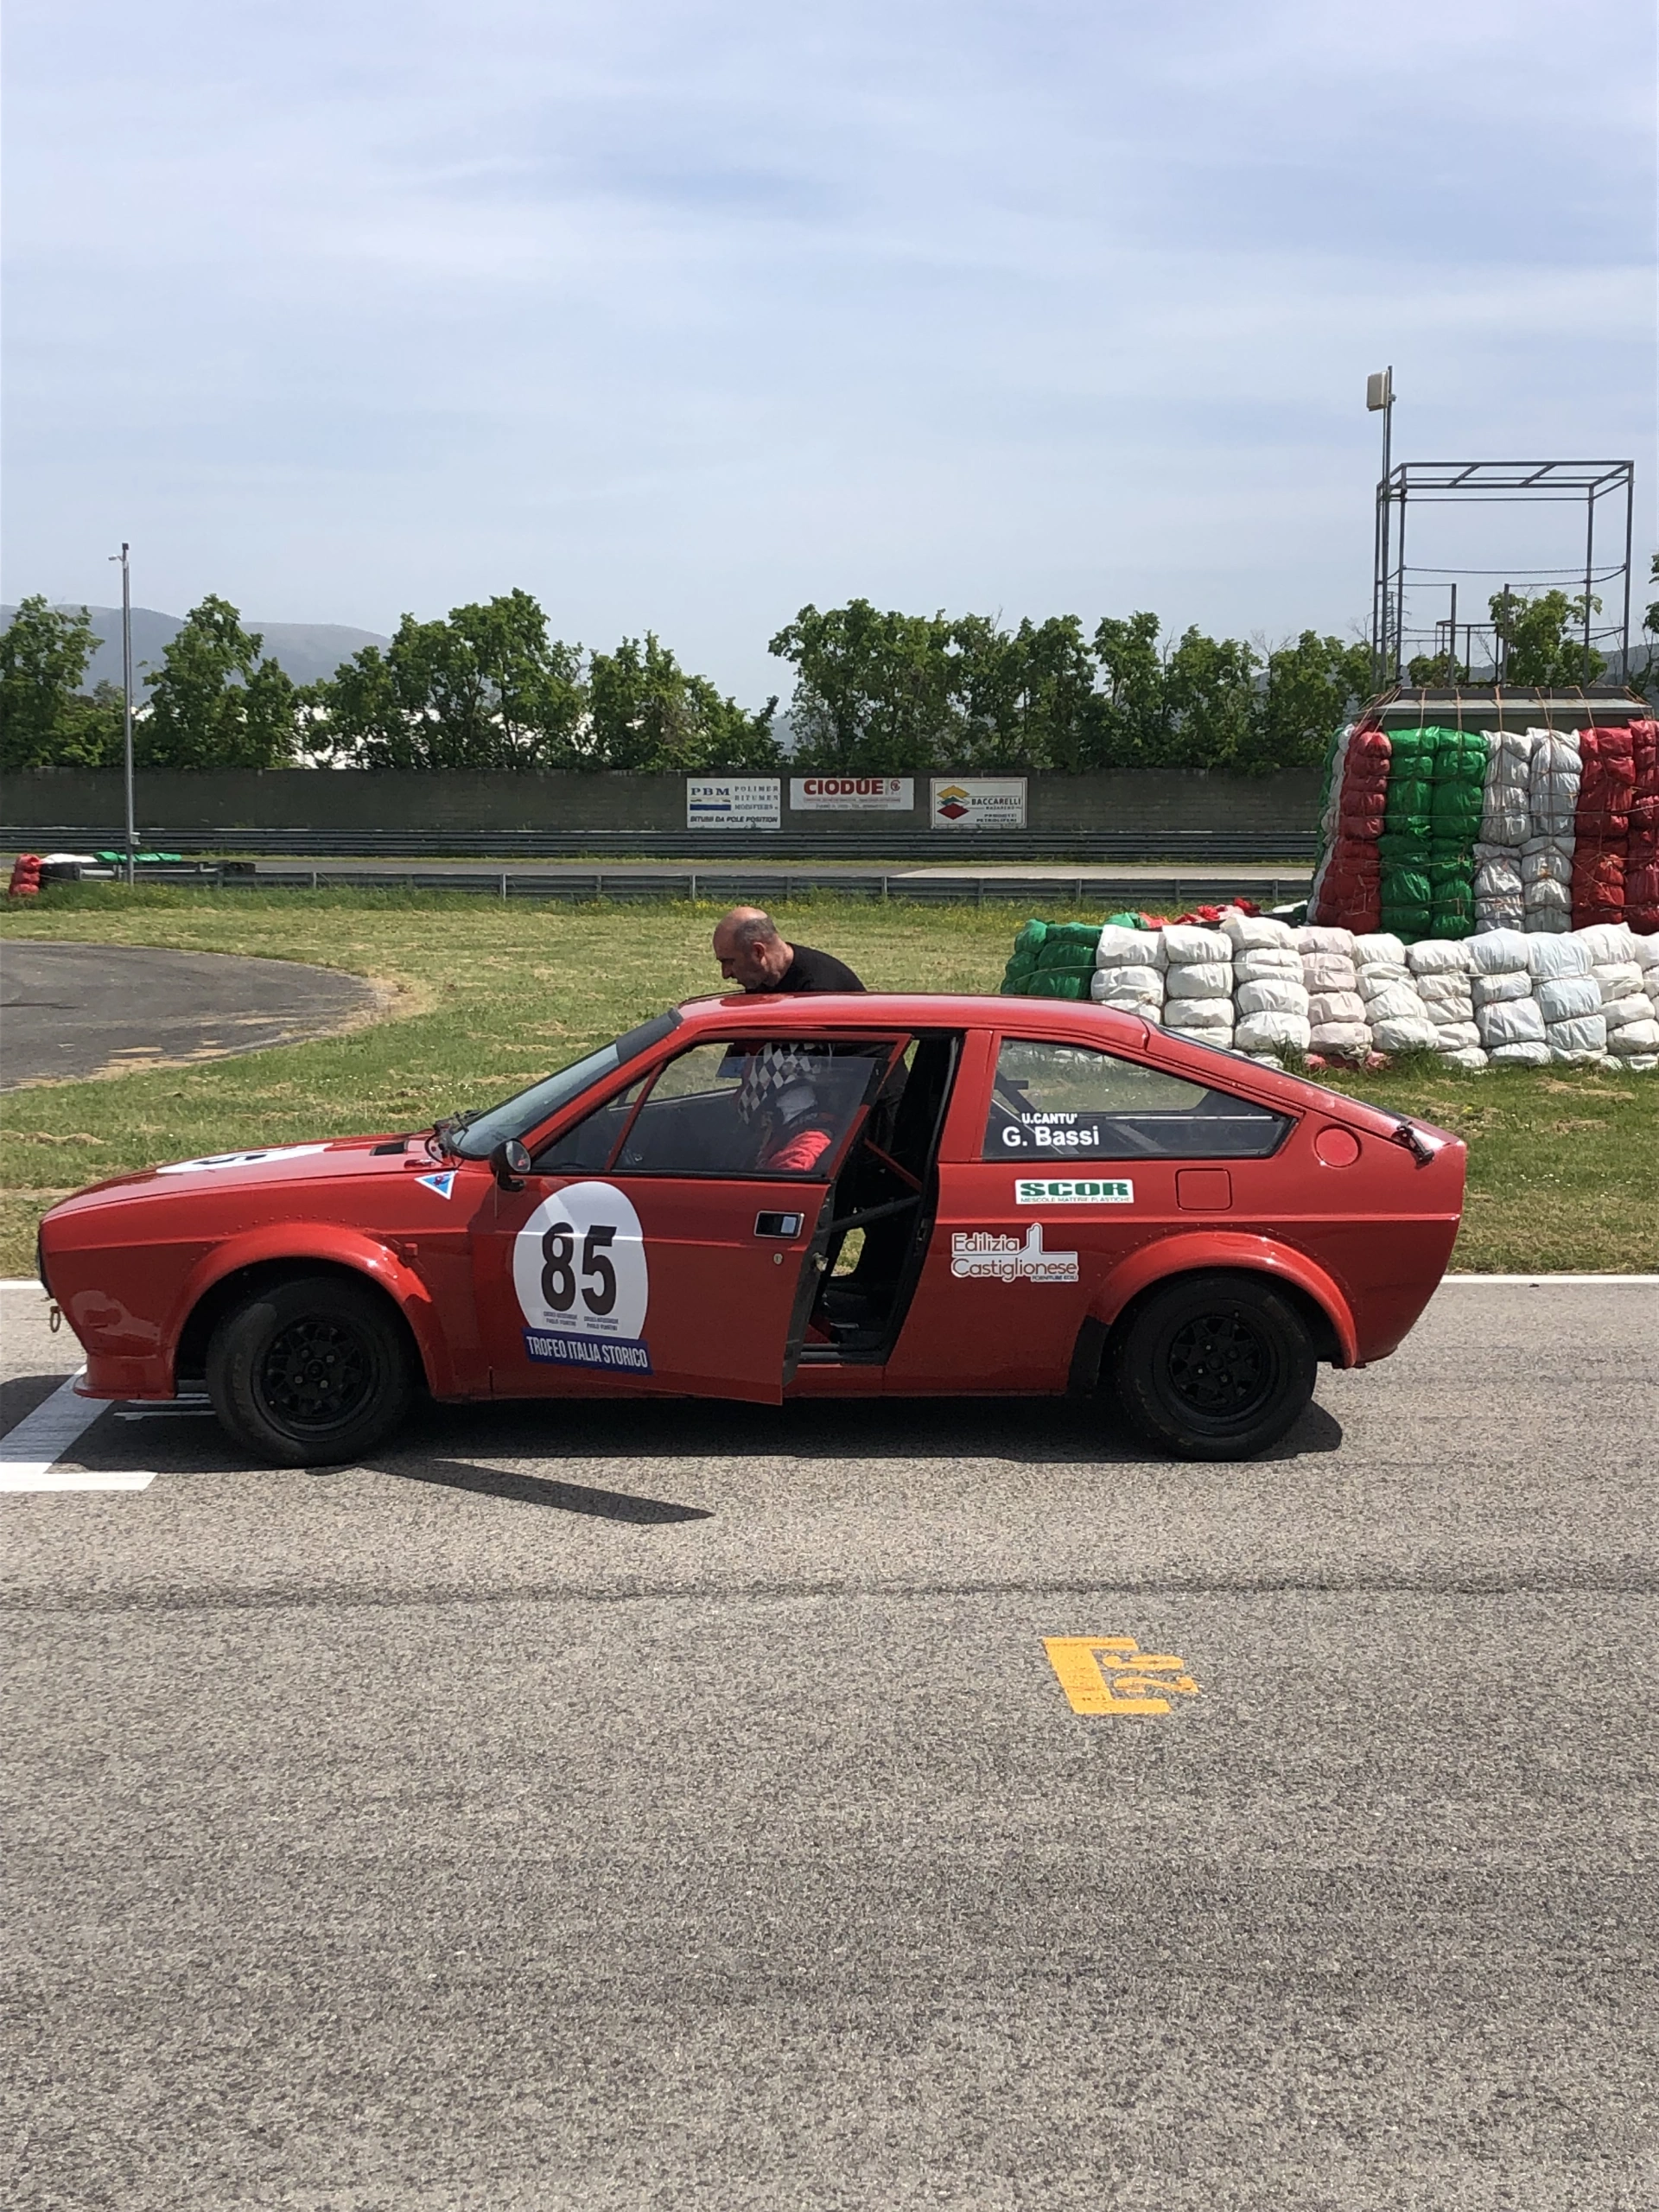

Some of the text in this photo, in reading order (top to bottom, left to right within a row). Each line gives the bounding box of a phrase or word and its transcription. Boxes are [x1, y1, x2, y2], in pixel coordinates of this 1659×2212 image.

[691, 787, 730, 796] PBM
[804, 779, 884, 795] CIODUE
[1002, 1125, 1100, 1147] G. Bassi
[1020, 1182, 1129, 1196] SCOR
[952, 1233, 1020, 1252] Edilizia
[541, 1222, 617, 1315] 85
[951, 1256, 1078, 1281] Castiglionese
[526, 1336, 648, 1368] TROFEO ITALIA STORICO
